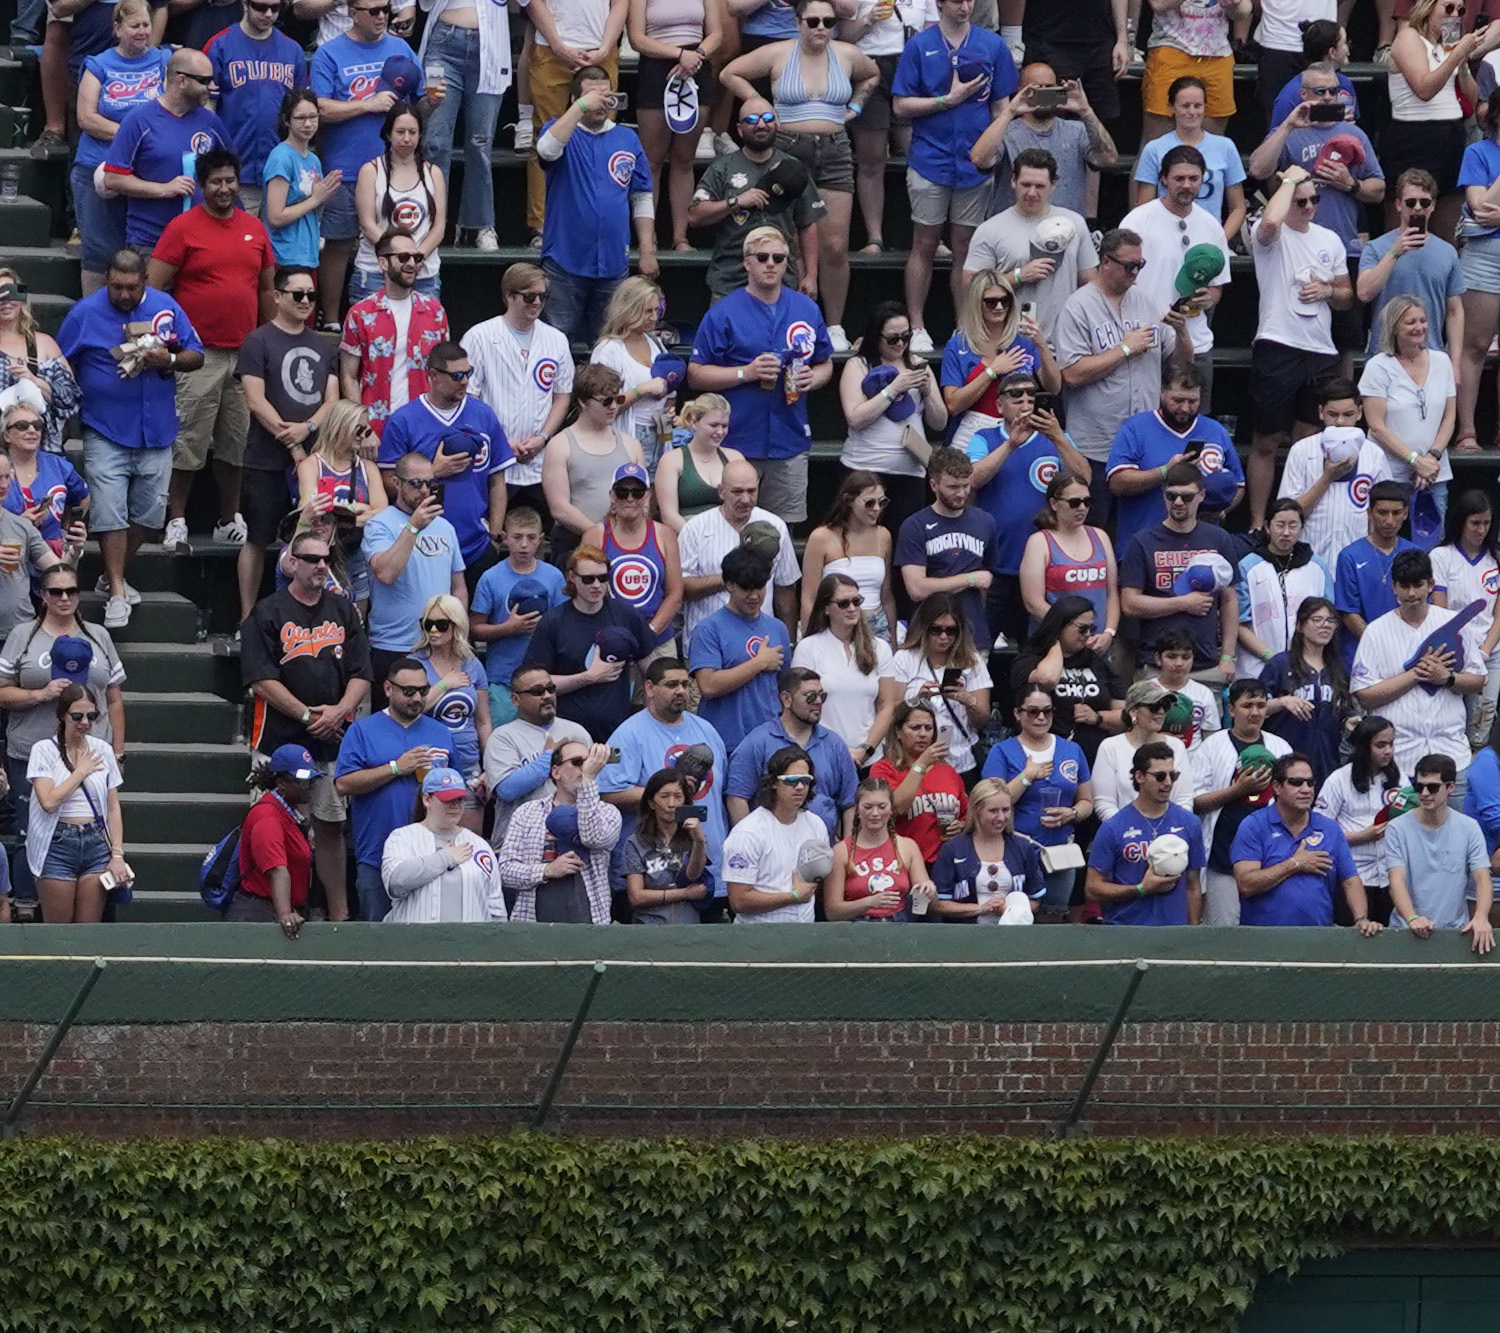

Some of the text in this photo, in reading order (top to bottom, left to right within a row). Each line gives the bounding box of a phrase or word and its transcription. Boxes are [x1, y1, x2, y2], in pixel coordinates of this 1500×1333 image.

[228, 60, 296, 91] CUBS
[924, 532, 985, 557] WRIGLEYVILLE
[1063, 569, 1108, 583] CUBS
[279, 620, 346, 648] Giants
[852, 859, 903, 878] USA
